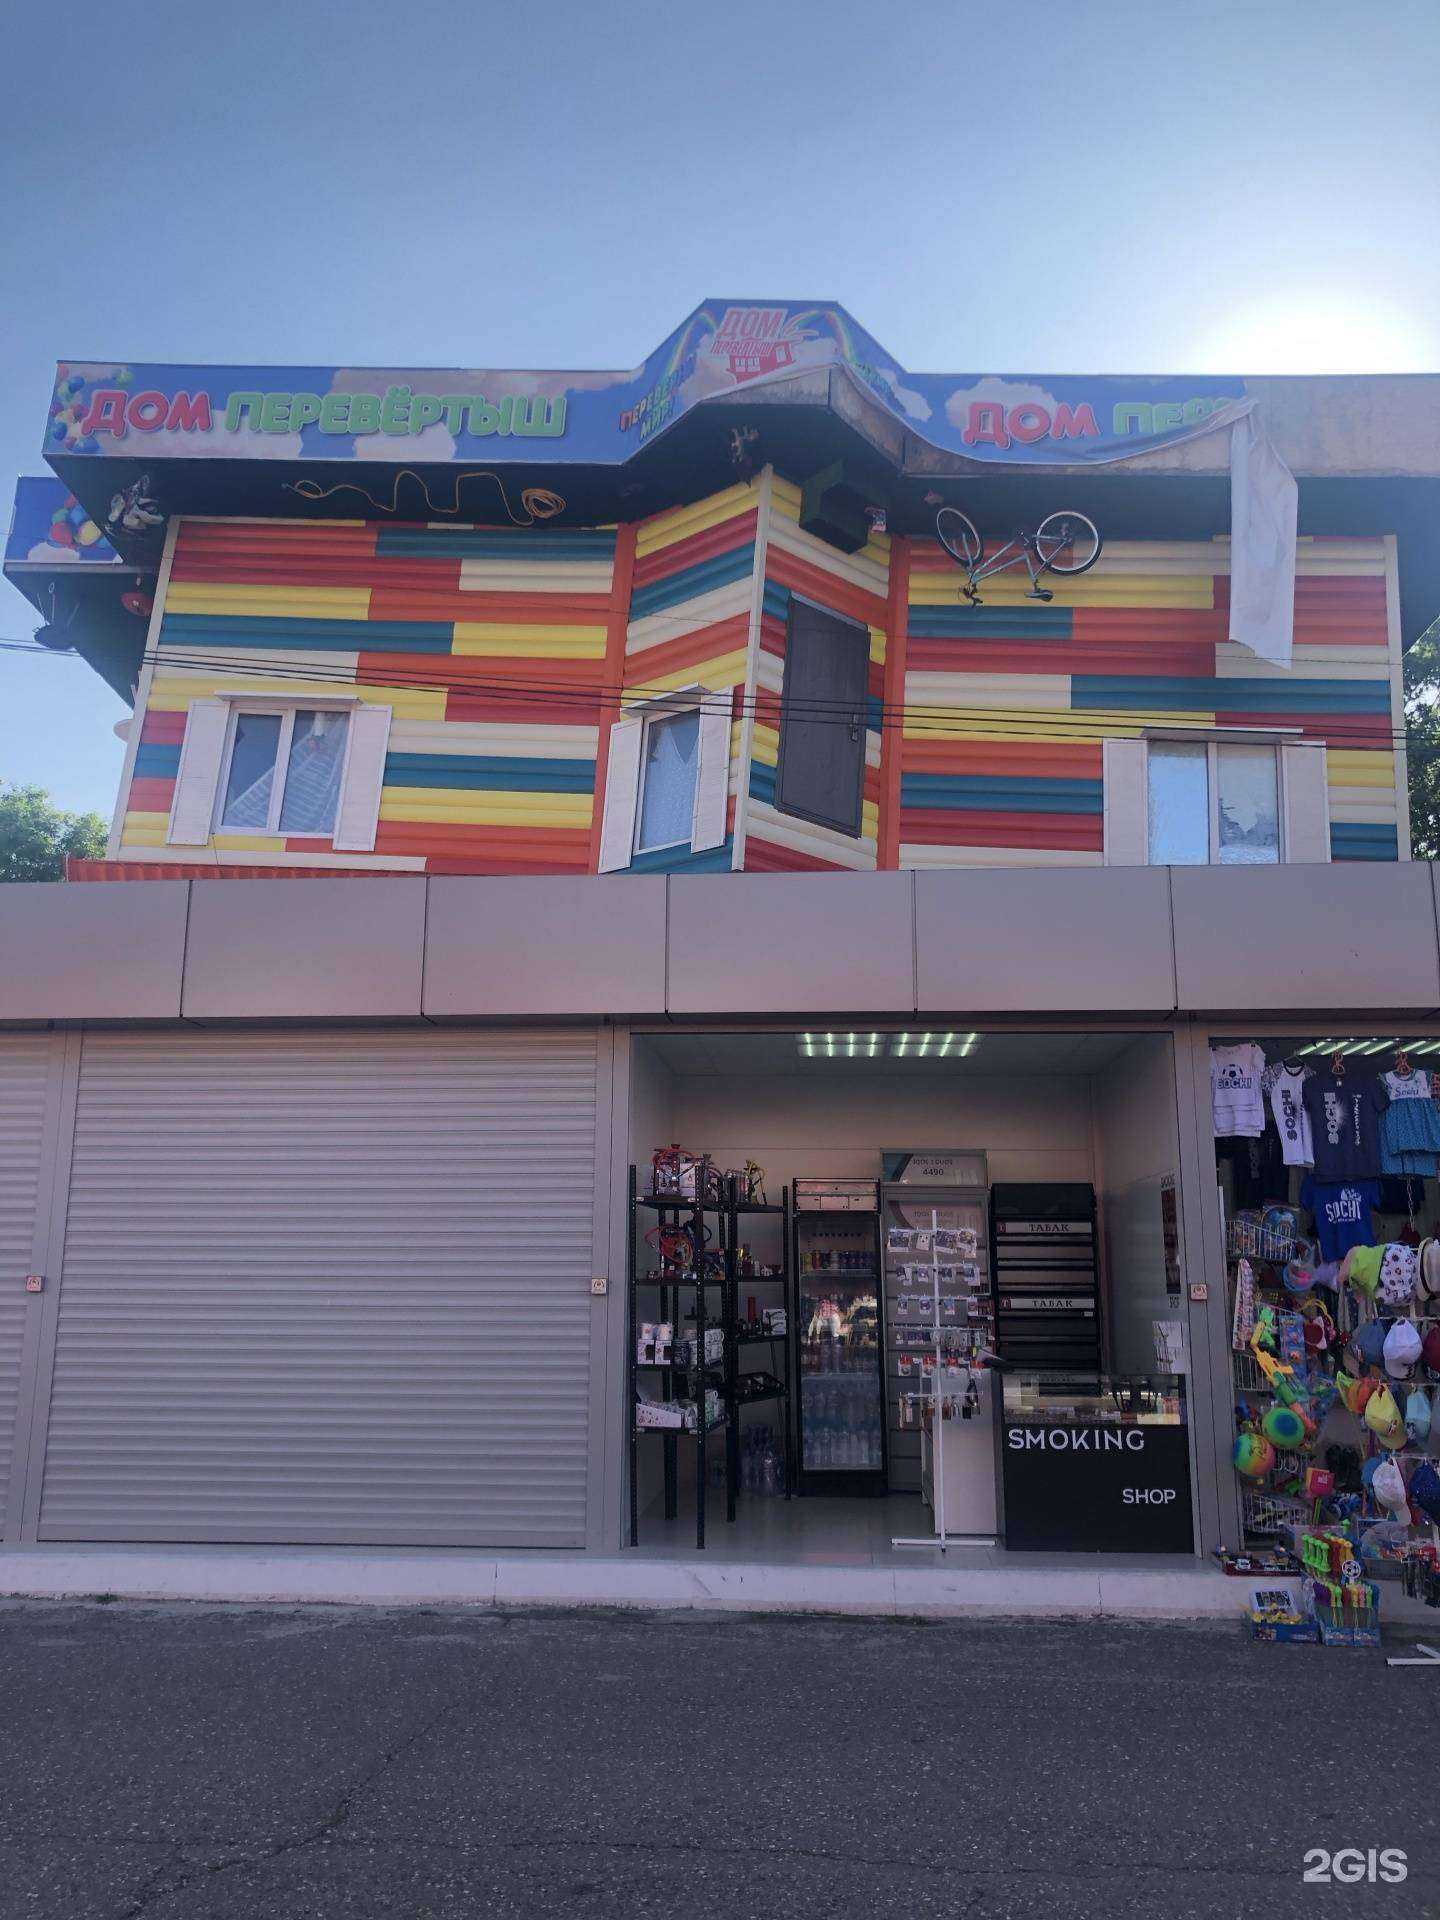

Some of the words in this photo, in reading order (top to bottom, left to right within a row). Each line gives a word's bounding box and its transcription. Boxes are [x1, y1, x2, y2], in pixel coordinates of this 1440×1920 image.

[715, 308, 783, 339] ДОМ
[81, 390, 213, 437] ДОМ
[225, 385, 567, 437] ПЕРЕВЁРТЫШ
[963, 401, 1099, 450] ДОМ
[1325, 1200, 1361, 1222] SOCHI
[1008, 1429, 1145, 1451] SMOKING
[1122, 1488, 1177, 1504] SHOP
